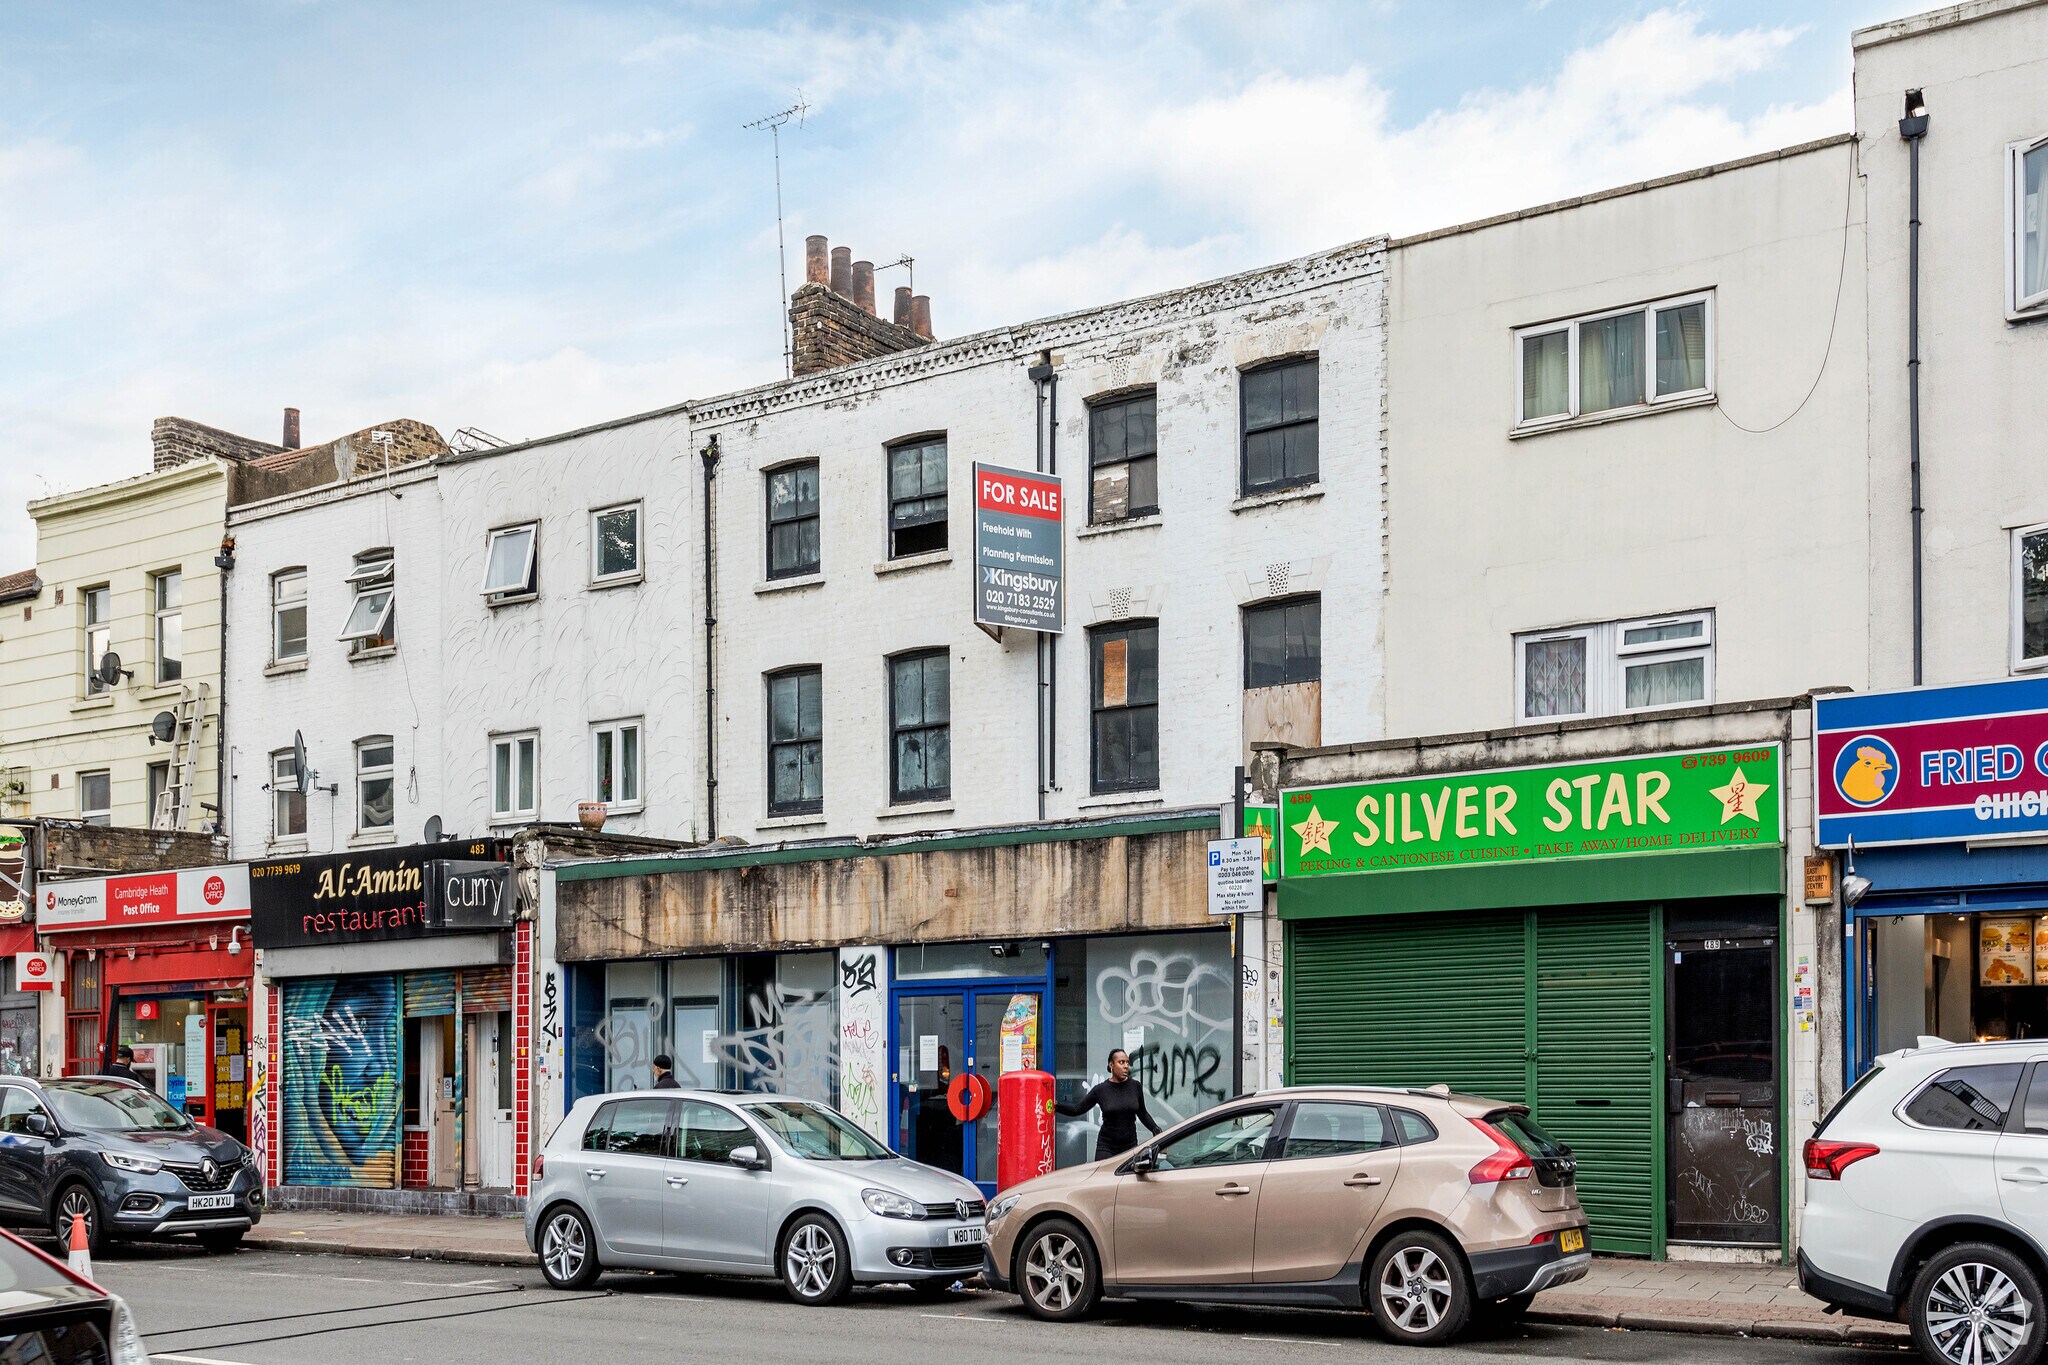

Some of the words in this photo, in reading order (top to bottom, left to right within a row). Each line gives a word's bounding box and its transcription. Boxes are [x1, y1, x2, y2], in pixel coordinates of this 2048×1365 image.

[983, 480, 1015, 505] FOR
[1020, 487, 1057, 512] SALE
[983, 522, 1015, 537] Freehold
[1016, 528, 1032, 539] With
[983, 547, 1014, 562] Planning
[1016, 552, 1054, 566] Permission
[990, 568, 1058, 597] Kingsbury
[986, 589, 1004, 604] 020
[1006, 592, 1030, 607] 7183
[1032, 596, 1055, 610] 2529
[1700, 754, 1727, 768] 739
[1733, 750, 1771, 765] 9609
[1921, 744, 2024, 787] FRIED
[1289, 792, 1312, 805] 489
[1352, 784, 1518, 847] SILVER
[1542, 771, 1671, 832] STAR
[470, 844, 485, 856] 483
[1300, 858, 1351, 873] PEKING
[1357, 857, 1365, 868] &
[1369, 850, 1454, 867] CANTONESE
[1459, 846, 1520, 860] CUISINE
[1534, 842, 1575, 855] TAKE
[1579, 834, 1673, 853] AWAY/HOME
[1679, 827, 1761, 845] DELIVERY
[1211, 853, 1219, 865] P
[252, 867, 265, 878] 020
[266, 865, 283, 877] 7739
[284, 863, 301, 875] 9619
[207, 882, 221, 890] POST
[313, 859, 422, 900] Al-Amin
[114, 887, 148, 900] Cambridge
[149, 884, 169, 896] Heath
[205, 891, 223, 900] OFFICE
[447, 877, 504, 917] curry
[57, 895, 97, 908] MoneyGram
[123, 905, 138, 916] Post
[140, 903, 160, 915] Office
[303, 901, 428, 935] restaurant
[1704, 940, 1720, 950] 489
[192, 1197, 214, 1208] HK20
[215, 1196, 231, 1207] WXU
[953, 1229, 968, 1243] W80
[969, 1229, 982, 1242] TOD
